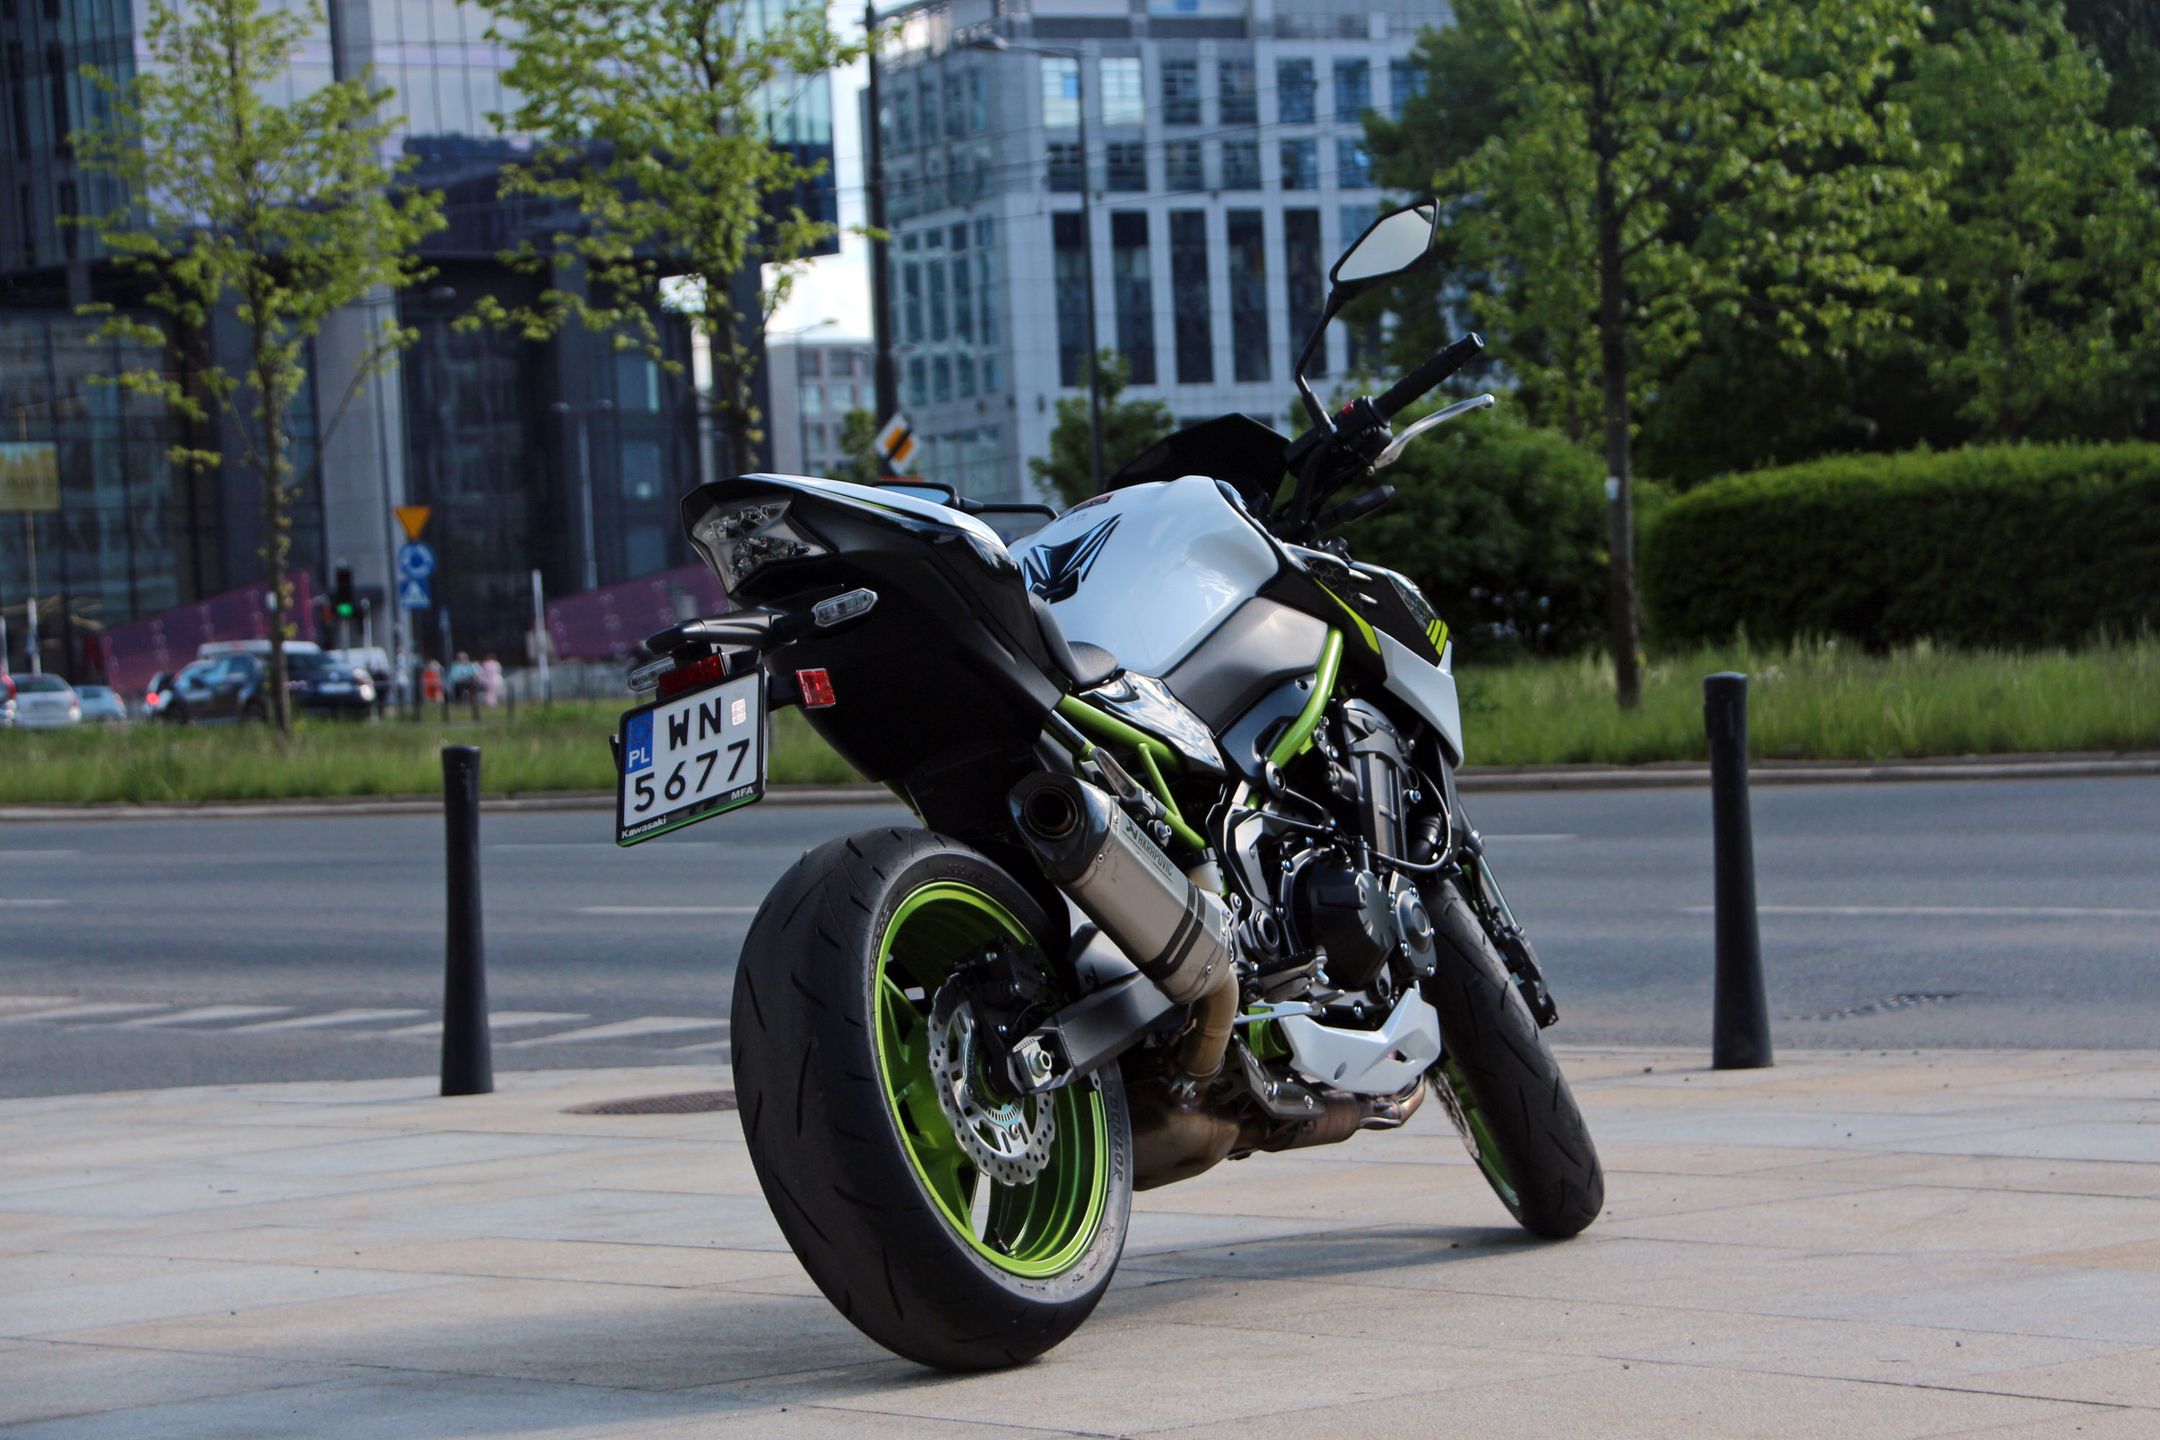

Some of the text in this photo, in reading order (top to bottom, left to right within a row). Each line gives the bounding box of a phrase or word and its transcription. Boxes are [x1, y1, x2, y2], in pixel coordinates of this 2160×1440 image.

[668, 696, 721, 751] WN
[628, 747, 650, 768] PL
[634, 738, 750, 812] 5677
[730, 786, 754, 801] MFA
[621, 815, 666, 838] Kawasaki
